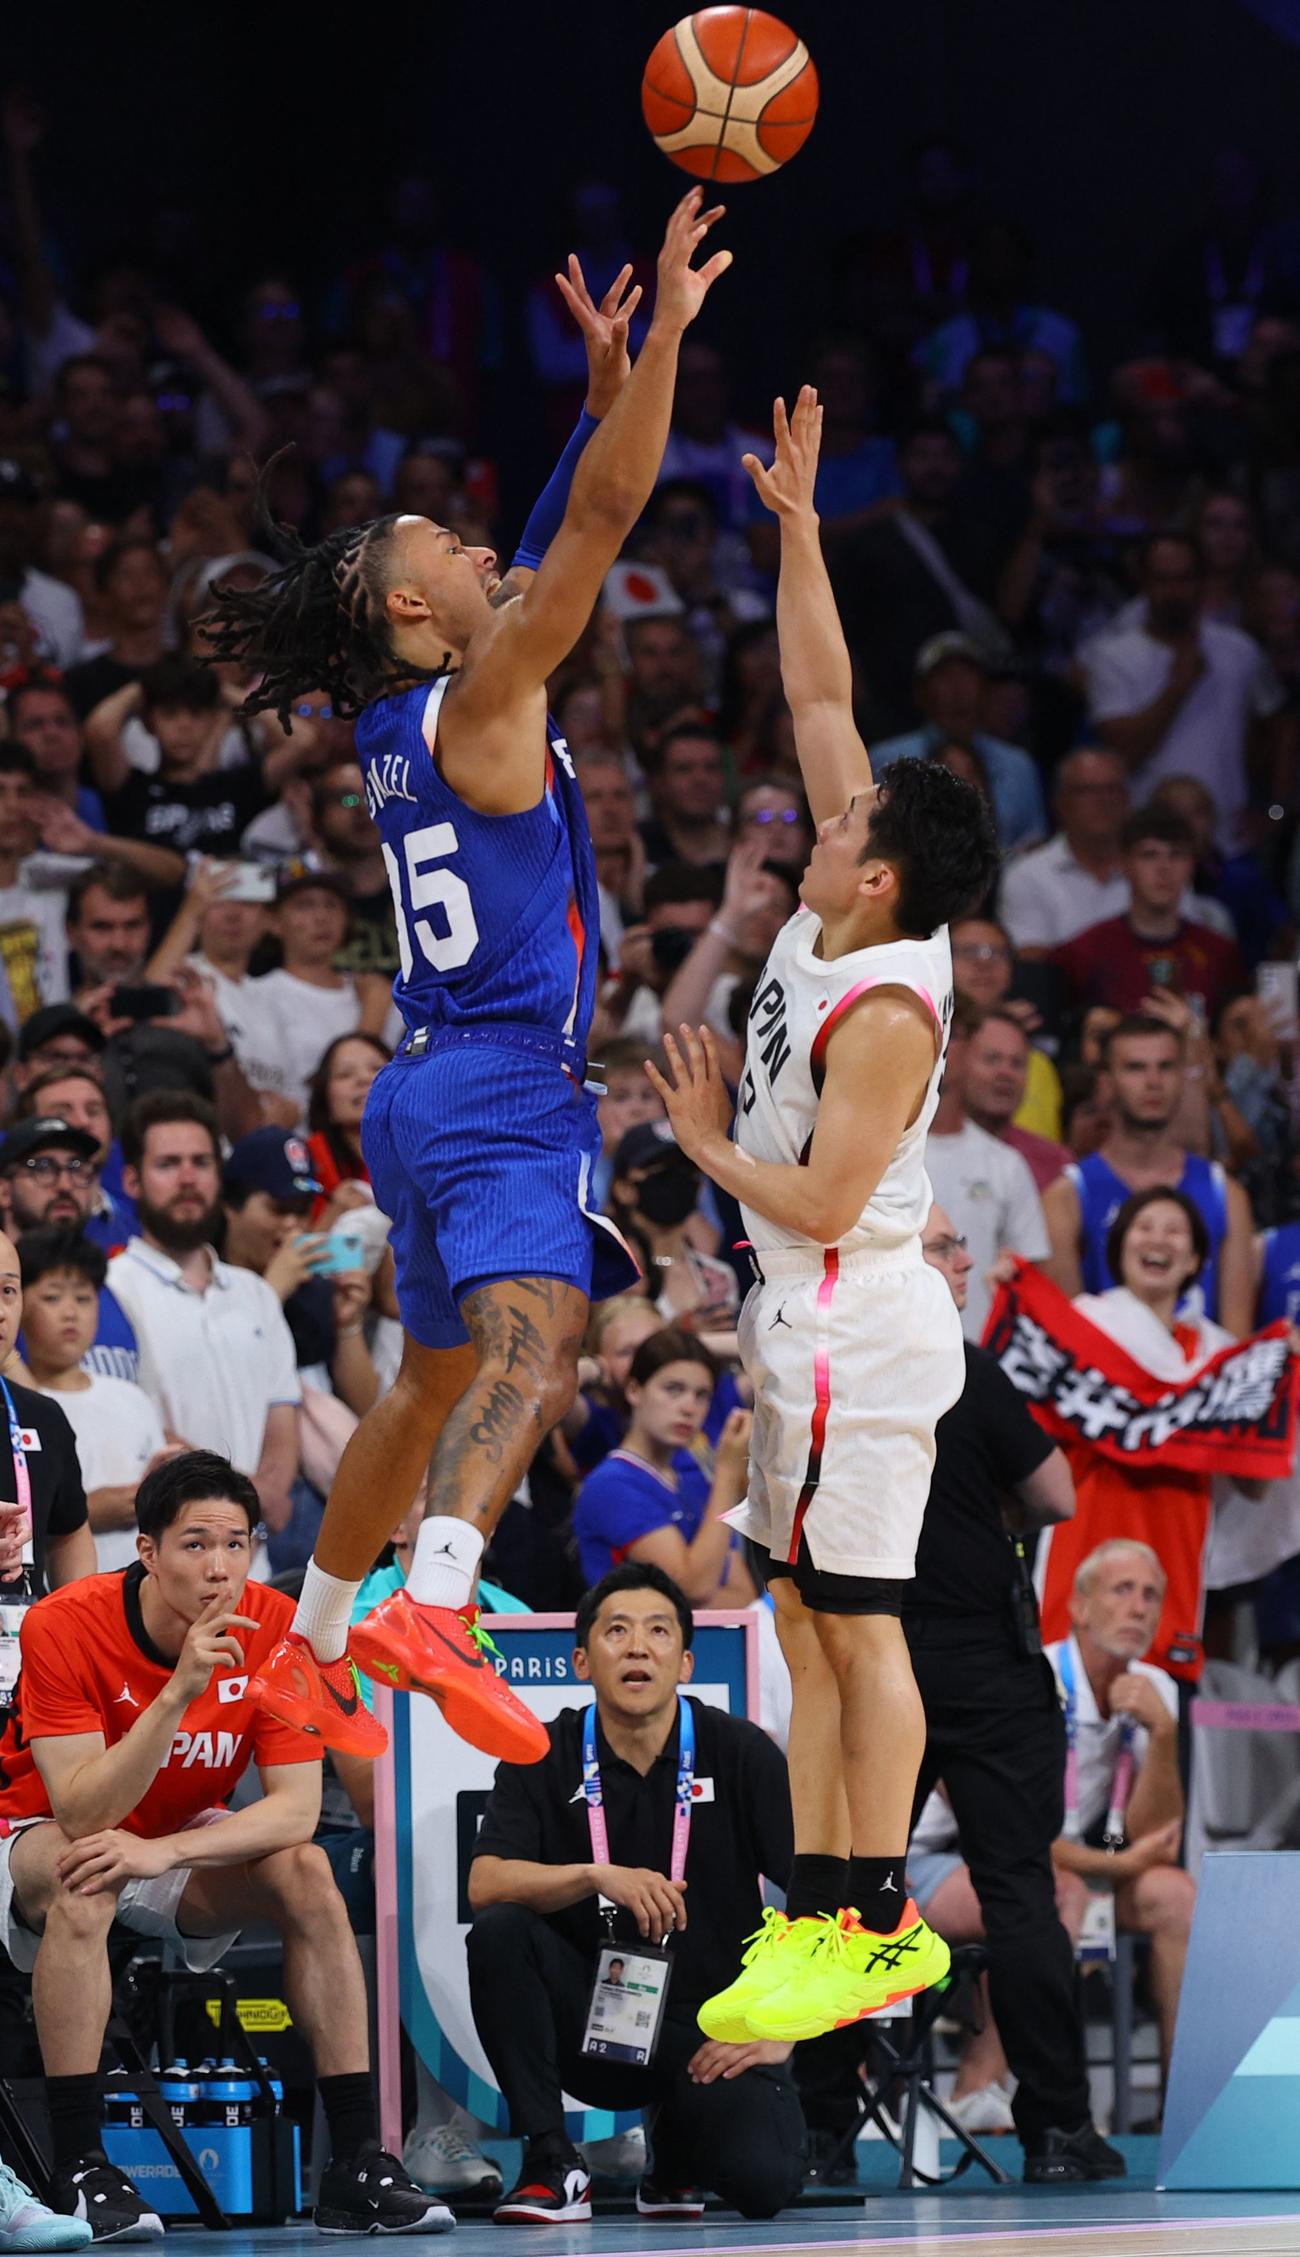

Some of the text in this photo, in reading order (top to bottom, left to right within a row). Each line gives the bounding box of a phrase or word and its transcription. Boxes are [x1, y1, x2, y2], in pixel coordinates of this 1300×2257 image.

[750, 966, 792, 1088] PAN
[159, 1730, 244, 1769] PAN
[116, 2164, 182, 2178] WERADE
